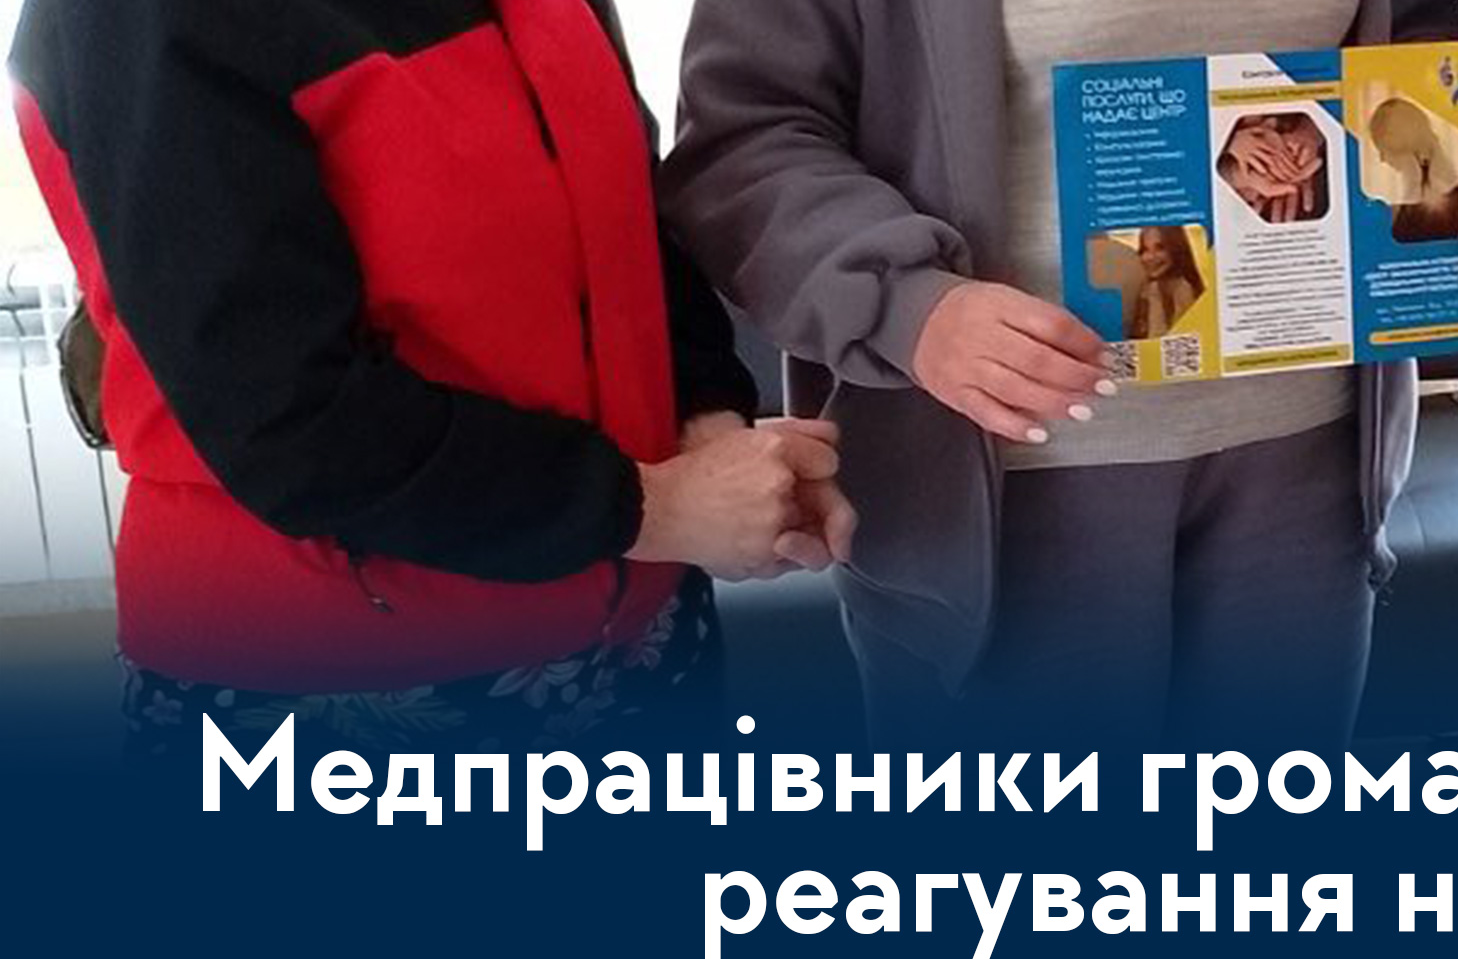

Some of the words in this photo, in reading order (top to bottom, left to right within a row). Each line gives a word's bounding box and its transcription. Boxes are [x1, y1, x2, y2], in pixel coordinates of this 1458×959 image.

[1081, 76, 1164, 95] СОЦІАЛЬНІ
[1159, 89, 1187, 104] ЩО
[1082, 107, 1138, 124] НАДАЄ
[1141, 104, 1187, 120] ЦЕНТР
